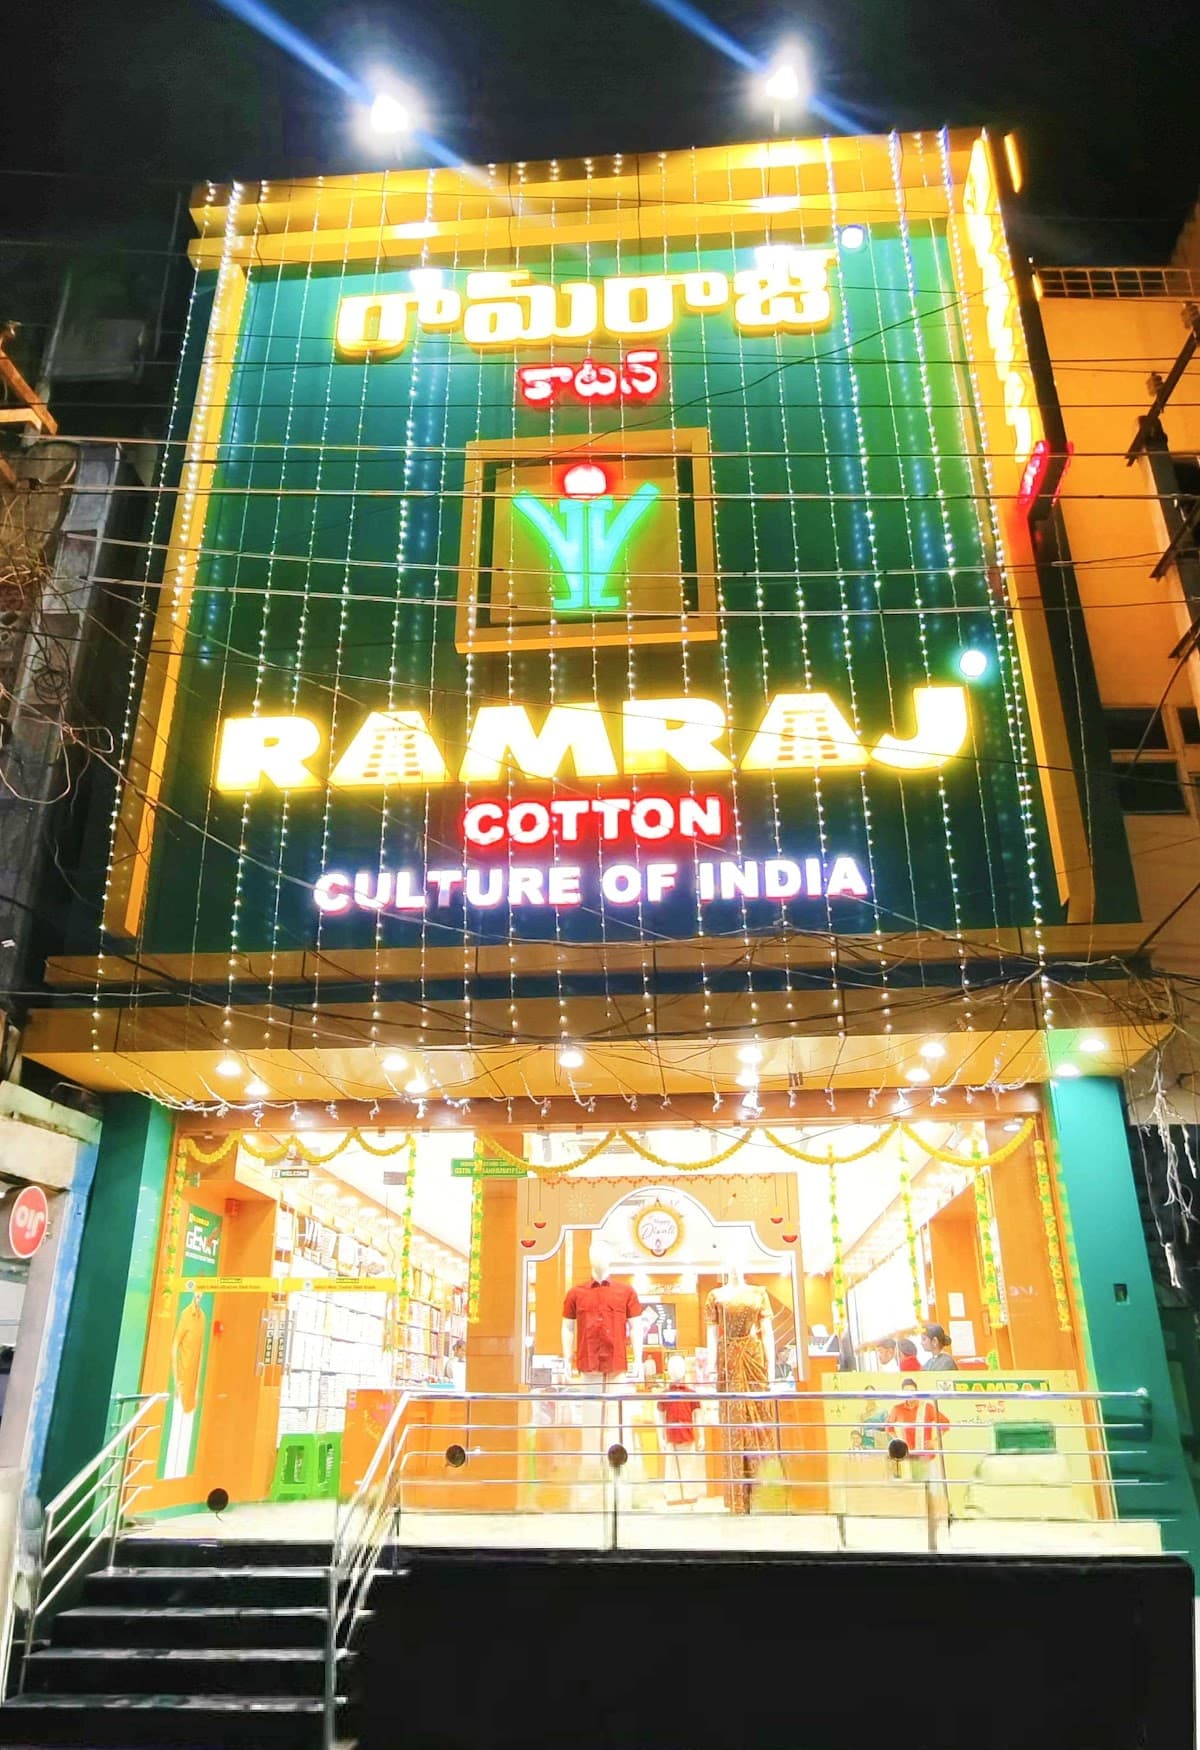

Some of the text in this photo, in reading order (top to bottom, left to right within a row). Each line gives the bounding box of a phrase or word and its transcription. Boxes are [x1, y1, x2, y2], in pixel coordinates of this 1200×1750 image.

[519, 349, 661, 401] కాటన్
[215, 686, 970, 792] RAMRAJ
[463, 797, 723, 845] COTTON
[313, 857, 870, 912] CULTURE OF INDIA
